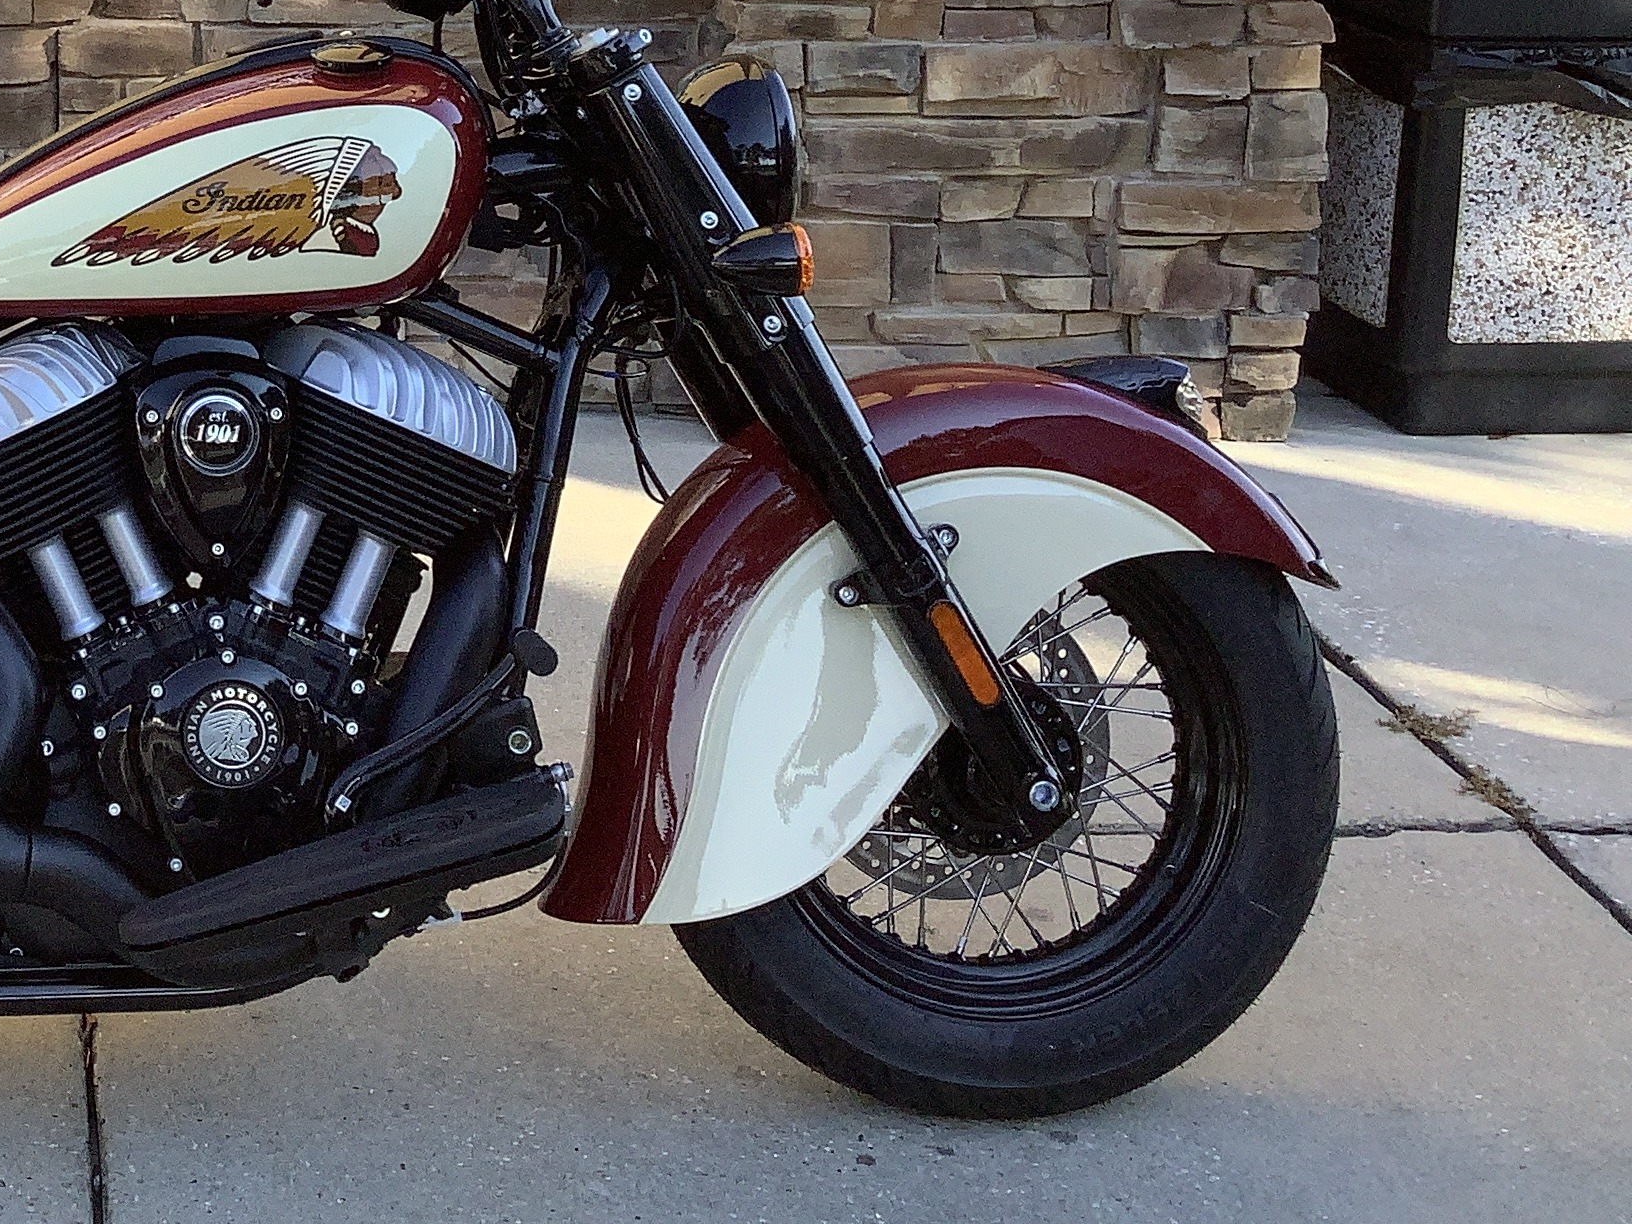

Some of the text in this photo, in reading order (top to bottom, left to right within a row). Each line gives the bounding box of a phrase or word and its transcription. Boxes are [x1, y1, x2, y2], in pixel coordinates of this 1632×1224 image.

[182, 181, 307, 214] Indian
[194, 423, 241, 444] 1901
[187, 687, 278, 764] INDIAN MOTORCYCLE
[216, 769, 251, 782] 1901
